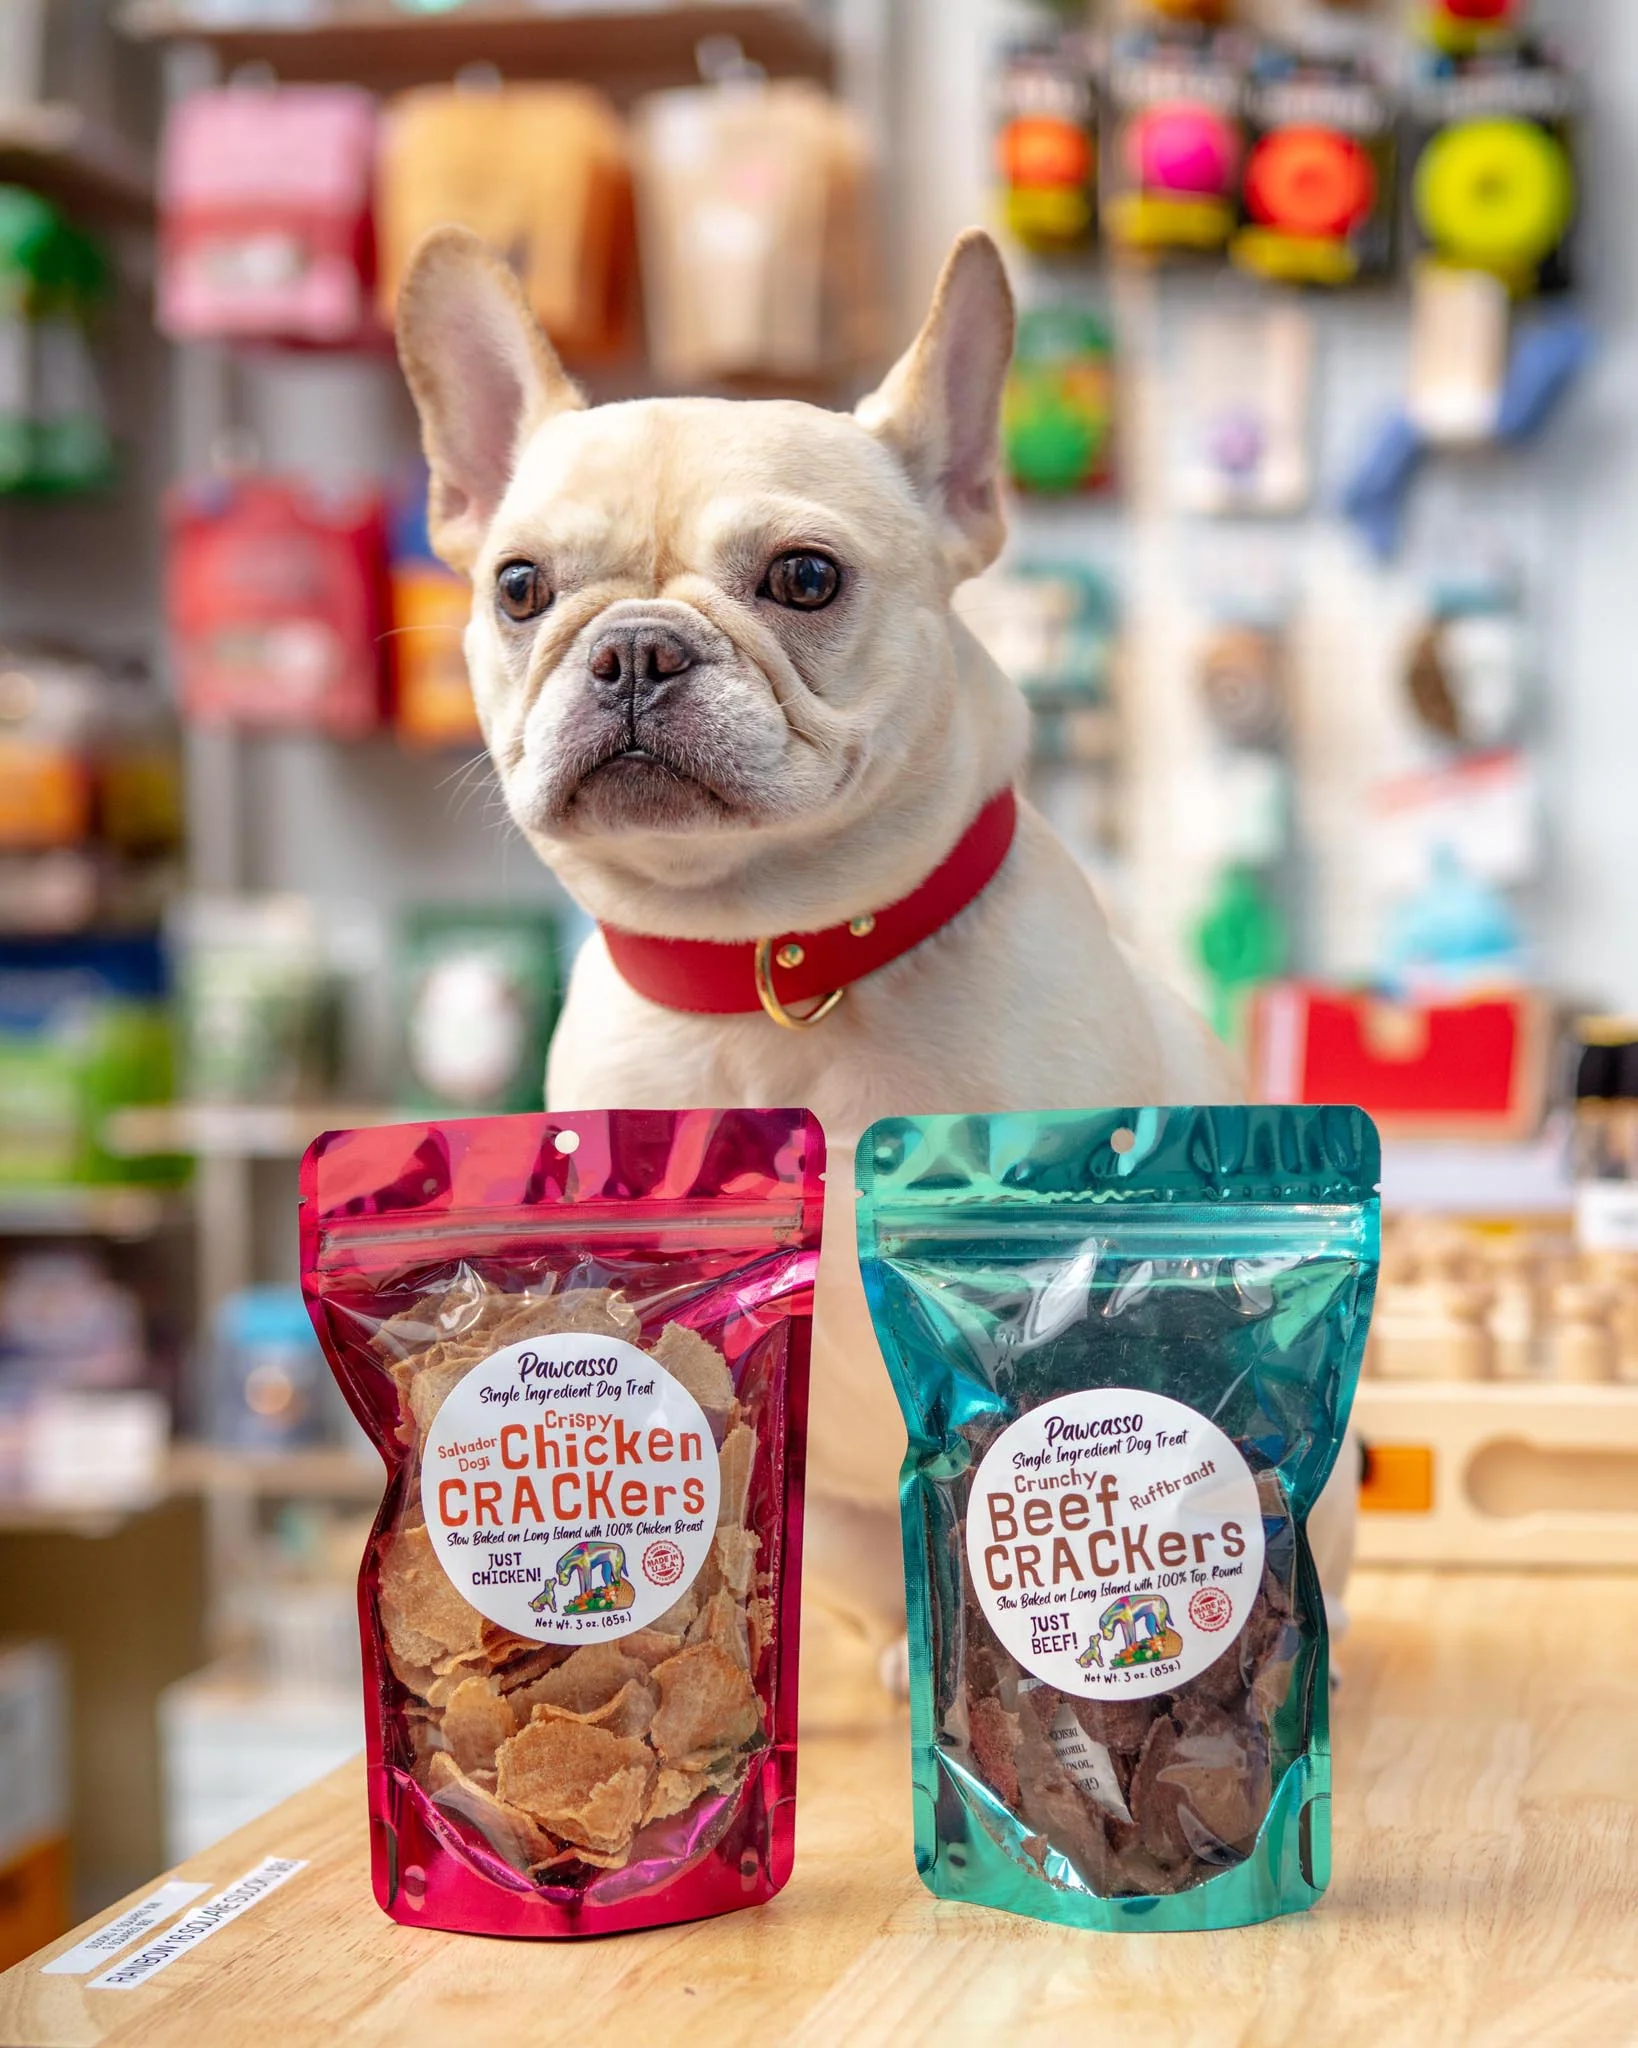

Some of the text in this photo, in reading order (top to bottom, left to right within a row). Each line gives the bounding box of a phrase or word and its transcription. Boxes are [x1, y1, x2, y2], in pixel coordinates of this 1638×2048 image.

[518, 1352, 618, 1383] Pawcasso
[479, 1379, 655, 1407] Single Ingredient Dog Treat
[544, 1409, 613, 1433] Crispy
[1044, 1414, 1143, 1447] Pawcasso
[438, 1437, 497, 1459] Salvador
[500, 1419, 703, 1470] Chicken
[1012, 1429, 1189, 1471] Single Ingredient Dog Treat
[458, 1456, 491, 1472] Dogi
[1014, 1468, 1098, 1493] Crunchy
[1129, 1460, 1216, 1511] Ruffbrandt
[986, 1474, 1119, 1542] Beef
[447, 1519, 704, 1548] Slow Baked on Long Island with 100% Chicken Breast
[487, 1552, 522, 1570] JUST
[647, 1553, 679, 1567] MADE IN
[472, 1567, 541, 1585] CHICKEN!
[996, 1596, 1018, 1611] Slow
[1020, 1594, 1050, 1609] Baked
[1054, 1592, 1067, 1603] on
[1070, 1589, 1097, 1604] Long
[1100, 1582, 1131, 1597] Island
[1134, 1581, 1153, 1592] with
[1157, 1572, 1187, 1589] 100%
[1211, 1562, 1243, 1580] Round
[1193, 1598, 1226, 1614] MADE IN
[535, 1612, 632, 1631] Net Wt. 3 oz. (85g.)
[1030, 1612, 1070, 1637] JUST
[1031, 1632, 1078, 1655] BEEF!
[1084, 1660, 1181, 1684] Net Wt. 3 oz. (85g.)
[106, 1945, 179, 1982] RAINBOW
[165, 1934, 195, 1942] 16
